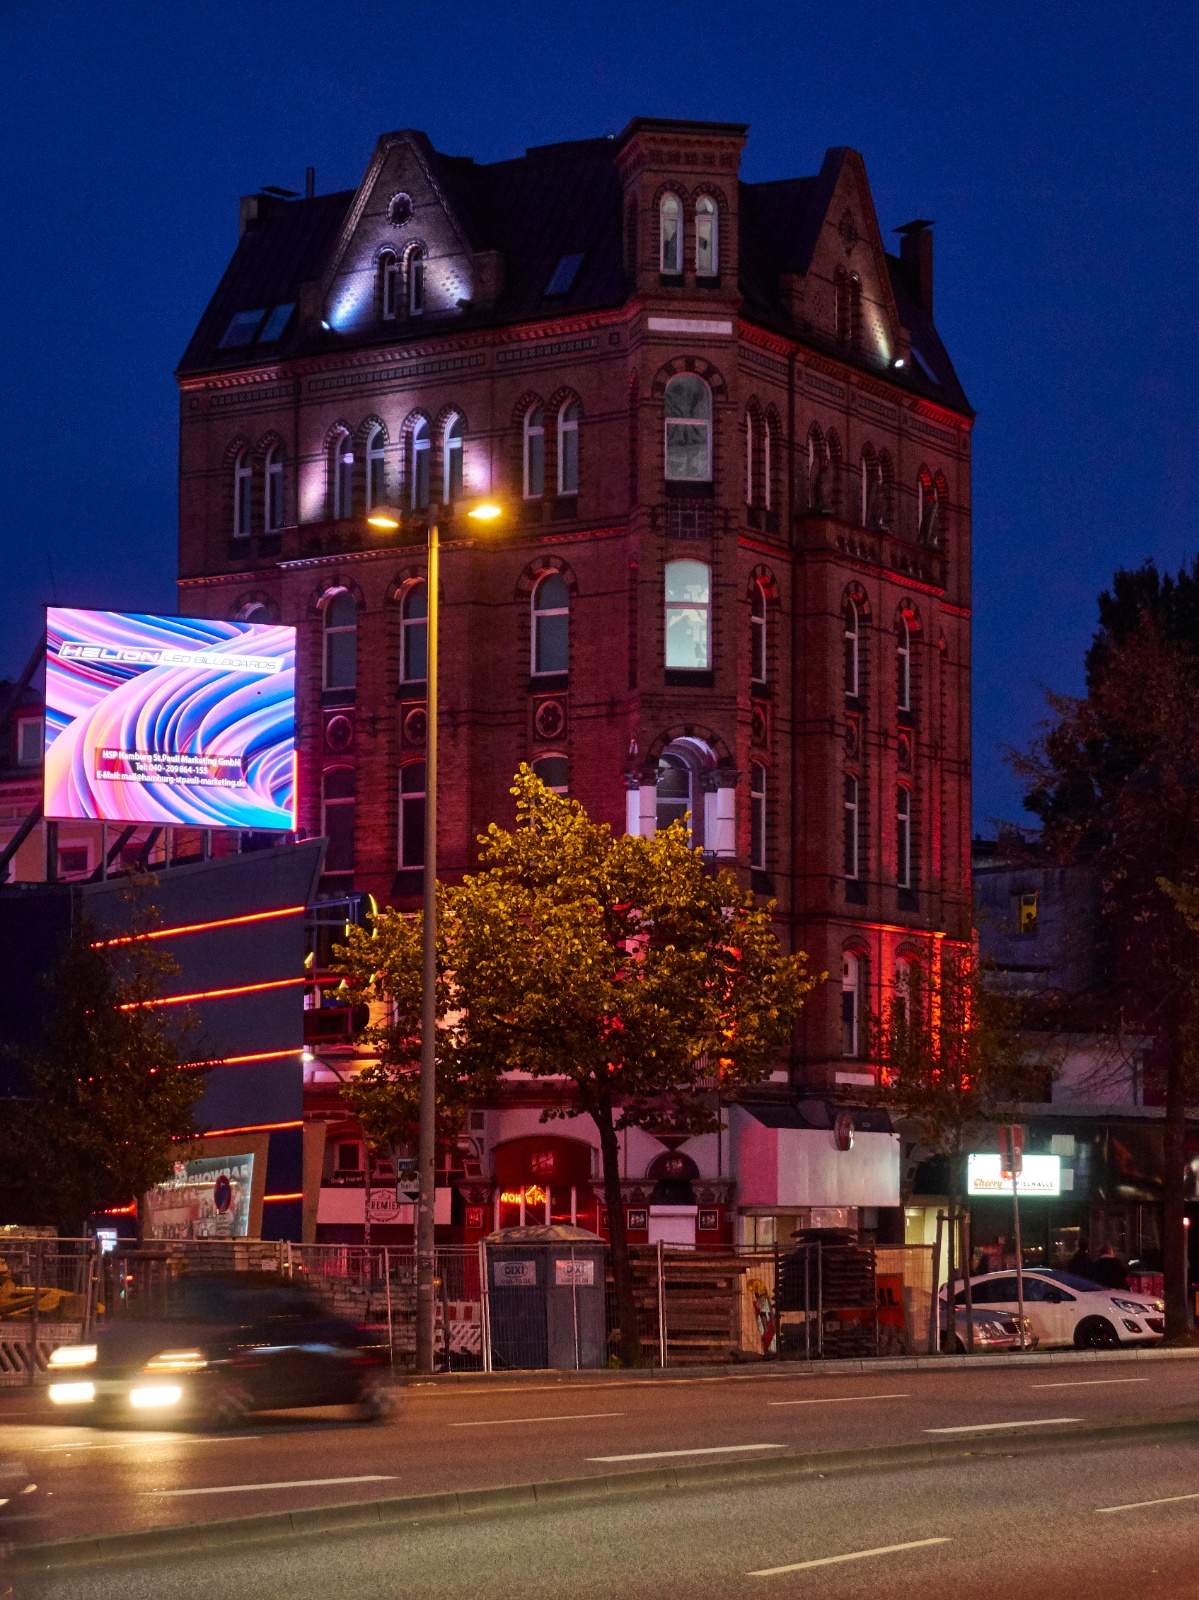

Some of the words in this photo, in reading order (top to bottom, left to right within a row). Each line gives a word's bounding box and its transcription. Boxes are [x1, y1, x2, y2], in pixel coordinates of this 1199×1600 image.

[62, 645, 161, 663] HELION
[163, 654, 191, 663] LED
[194, 656, 277, 669] BILLBOARDS
[103, 750, 118, 759] HSP
[118, 751, 152, 763] Hamburg
[181, 755, 218, 766] Marketing
[217, 758, 241, 766] GmbH
[135, 762, 147, 770] Tel:
[974, 1178, 1003, 1190] Cherry
[504, 1266, 524, 1275] DIXI
[566, 1264, 585, 1274] DXI
